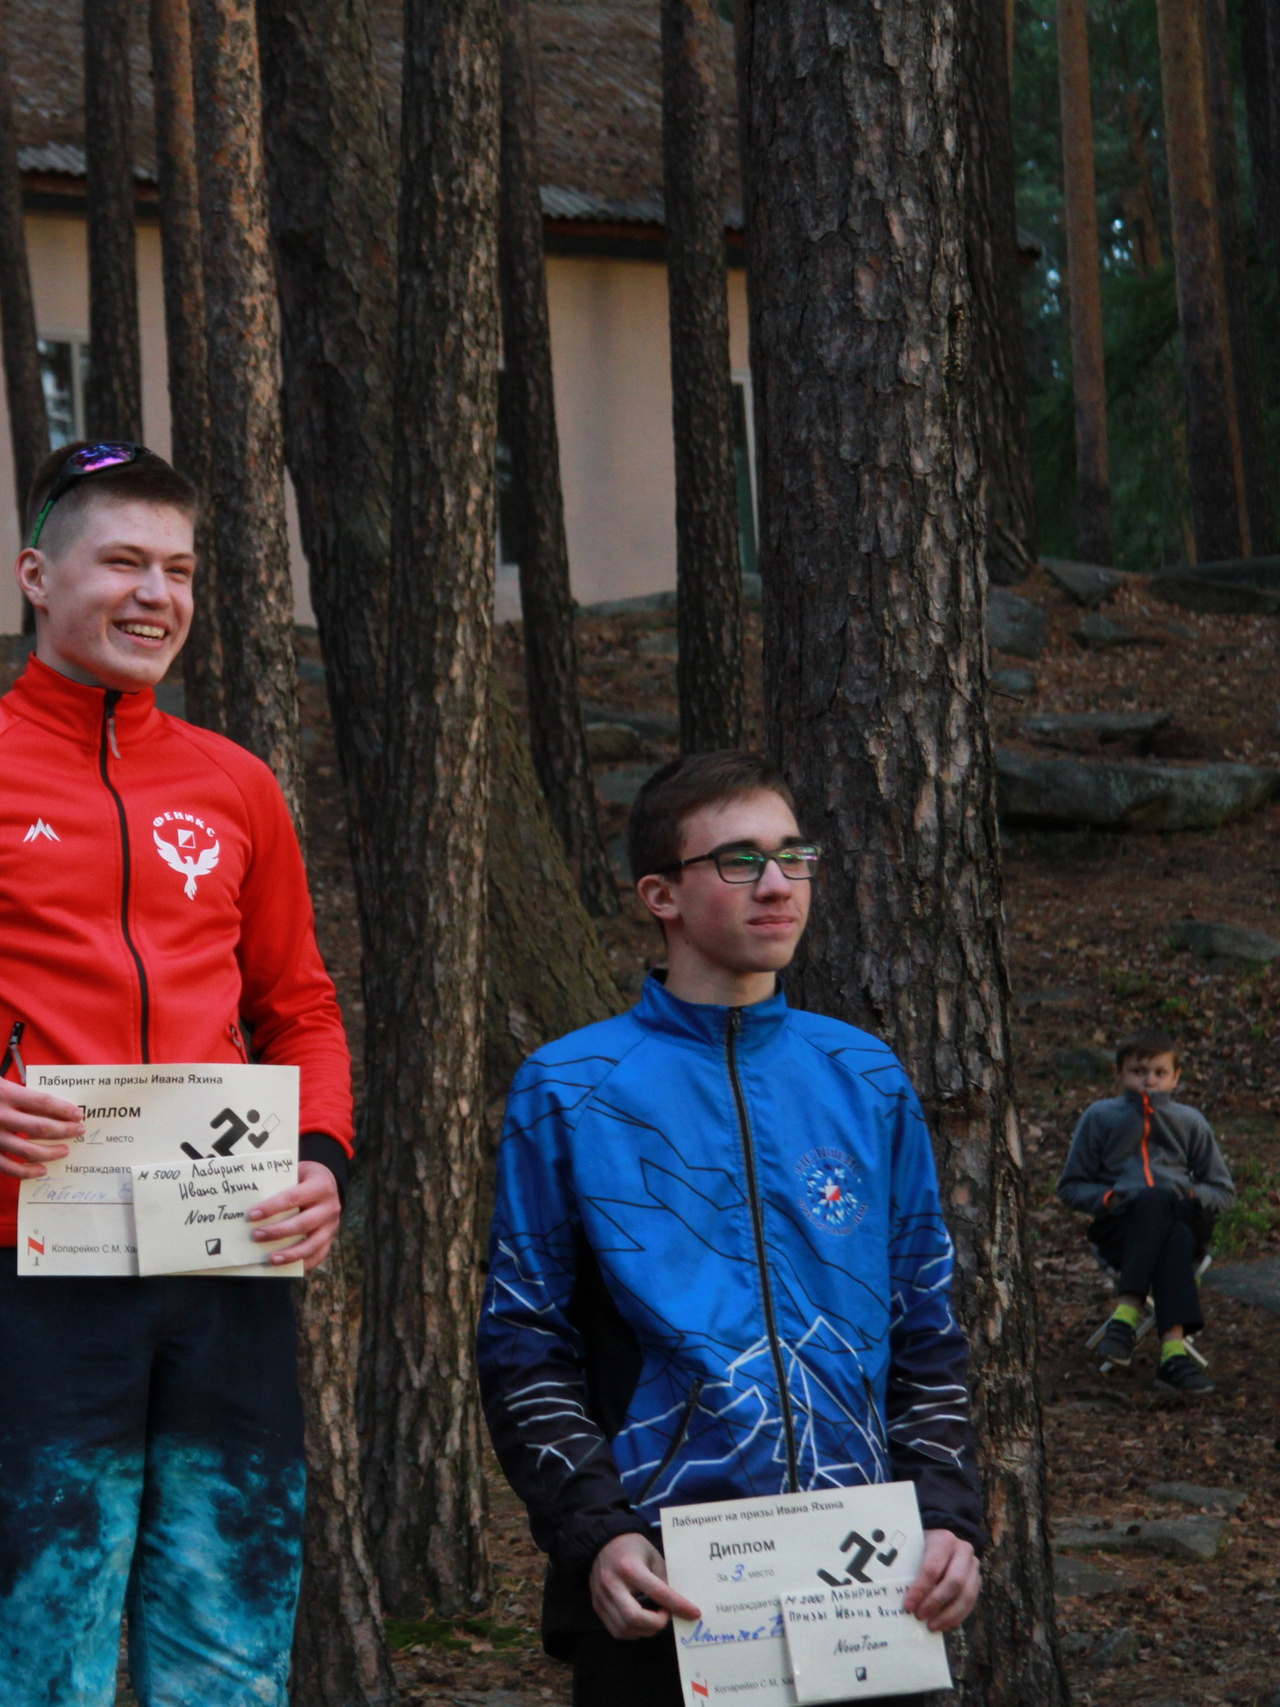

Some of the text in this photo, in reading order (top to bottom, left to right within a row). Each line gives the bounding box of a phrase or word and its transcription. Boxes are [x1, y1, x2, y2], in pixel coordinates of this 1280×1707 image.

[153, 811, 216, 837] ФЕНИКС
[38, 1074, 223, 1087] Лабиринт на призы Ивана Яхина
[106, 1135, 134, 1143] место
[65, 1164, 131, 1176] Награждаетс
[153, 1169, 181, 1180] 5000
[192, 1162, 245, 1181] Лабиринт
[179, 1181, 217, 1200] Ивана
[51, 1243, 99, 1255] Копарейко
[672, 1499, 844, 1527] Лабиринт на призы Ивана Яхина
[709, 1538, 776, 1560] Диплом
[716, 1563, 775, 1583] За 3 место
[716, 1598, 781, 1614] Награждаетс
